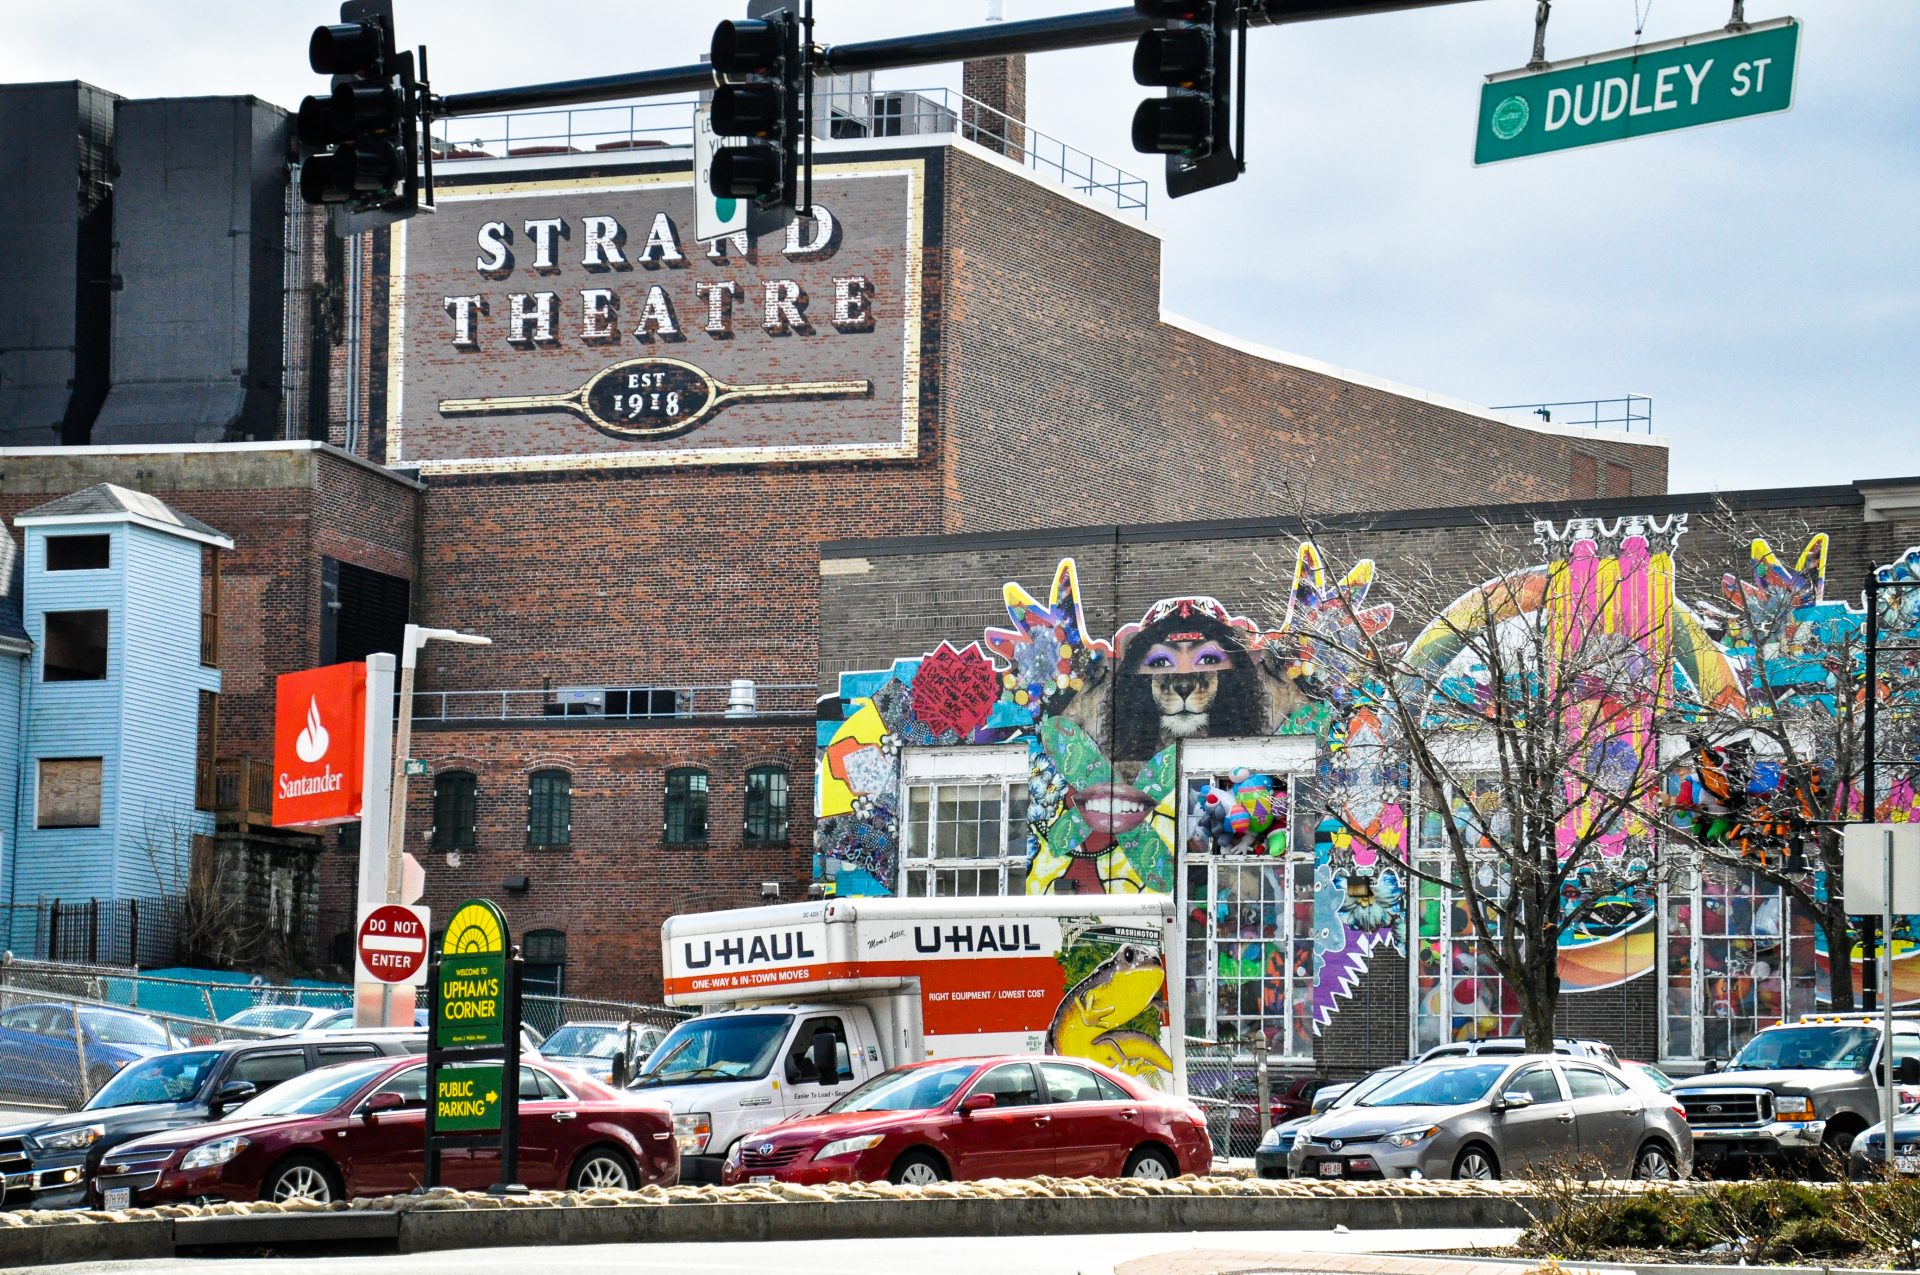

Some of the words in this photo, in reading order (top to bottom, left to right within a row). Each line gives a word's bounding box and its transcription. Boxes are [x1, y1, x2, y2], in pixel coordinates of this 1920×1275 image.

[1544, 58, 1714, 132] DUDLEY
[1730, 57, 1772, 97] ST
[444, 276, 870, 348] THEATRE
[627, 372, 666, 389] EST
[614, 391, 680, 419] 1918
[279, 764, 343, 800] Santander
[369, 919, 387, 934] DO
[393, 919, 418, 934] NOT
[1114, 927, 1159, 939] WASHINGTON
[914, 924, 1041, 953] U-HAUL
[685, 931, 815, 969] U-HAUL
[371, 954, 411, 969] ENTER
[456, 968, 479, 976] WELCOME
[480, 967, 488, 975] TO
[692, 977, 730, 990] ONE-WAY
[731, 976, 739, 986] &
[740, 972, 777, 985] IN-TOWN
[779, 969, 809, 982] MOVES
[444, 978, 499, 999] UPHAM'S
[929, 992, 949, 1001] RIGHT
[952, 990, 991, 1000] EQUIPMENT
[998, 989, 1025, 999] LOWEST
[1027, 988, 1045, 998] COST
[445, 1000, 495, 1019] CORNER
[438, 1081, 473, 1098] PUBLIC
[438, 1099, 486, 1118] PARKING
